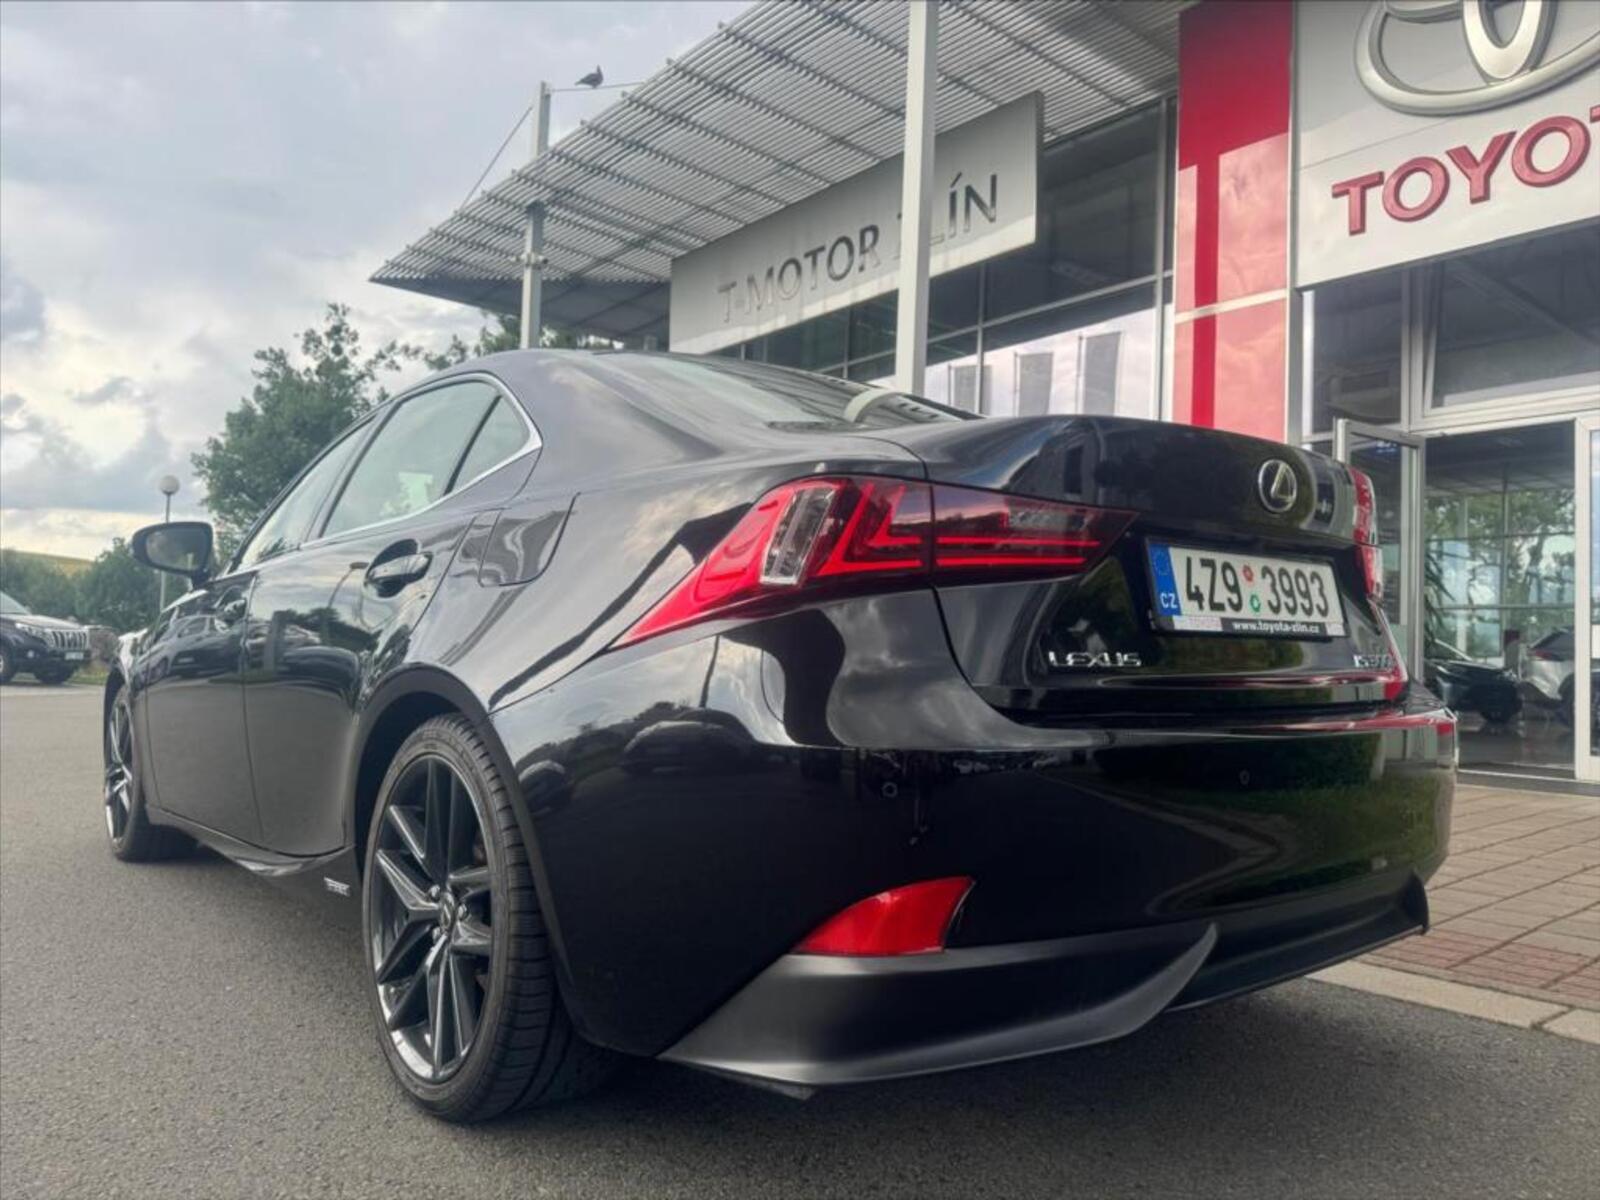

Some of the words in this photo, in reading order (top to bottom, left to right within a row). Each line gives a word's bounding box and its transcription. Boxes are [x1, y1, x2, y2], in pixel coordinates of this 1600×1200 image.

[1332, 105, 1600, 236] TOYO
[1160, 592, 1178, 609] CZ
[1186, 556, 1243, 612] 4Z9
[1261, 565, 1329, 617] 3993
[1048, 651, 1142, 668] LEXUS
